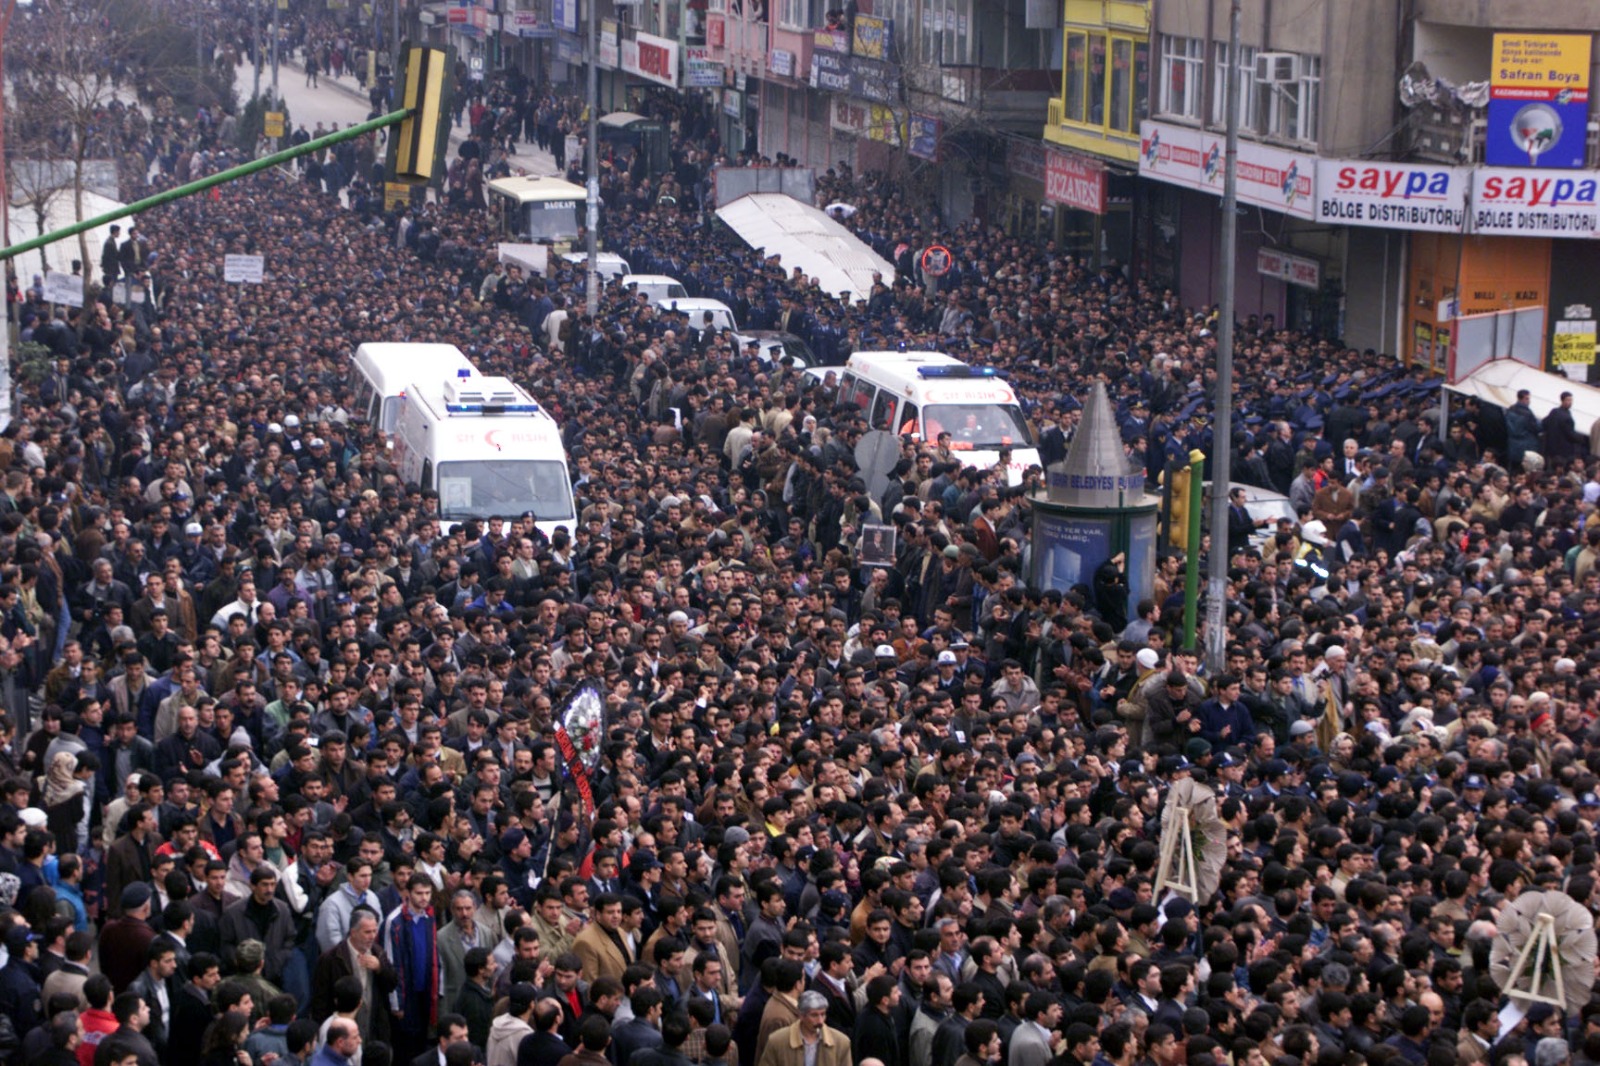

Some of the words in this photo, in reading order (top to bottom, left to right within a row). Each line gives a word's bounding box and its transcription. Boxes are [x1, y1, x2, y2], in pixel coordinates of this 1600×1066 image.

[1500, 69, 1543, 80] Safran
[1549, 70, 1581, 83] Boya
[1336, 167, 1450, 199] saypa
[1482, 176, 1597, 207] saypa
[1322, 198, 1363, 220] BÖLGE
[1478, 209, 1513, 229] BÖLGE
